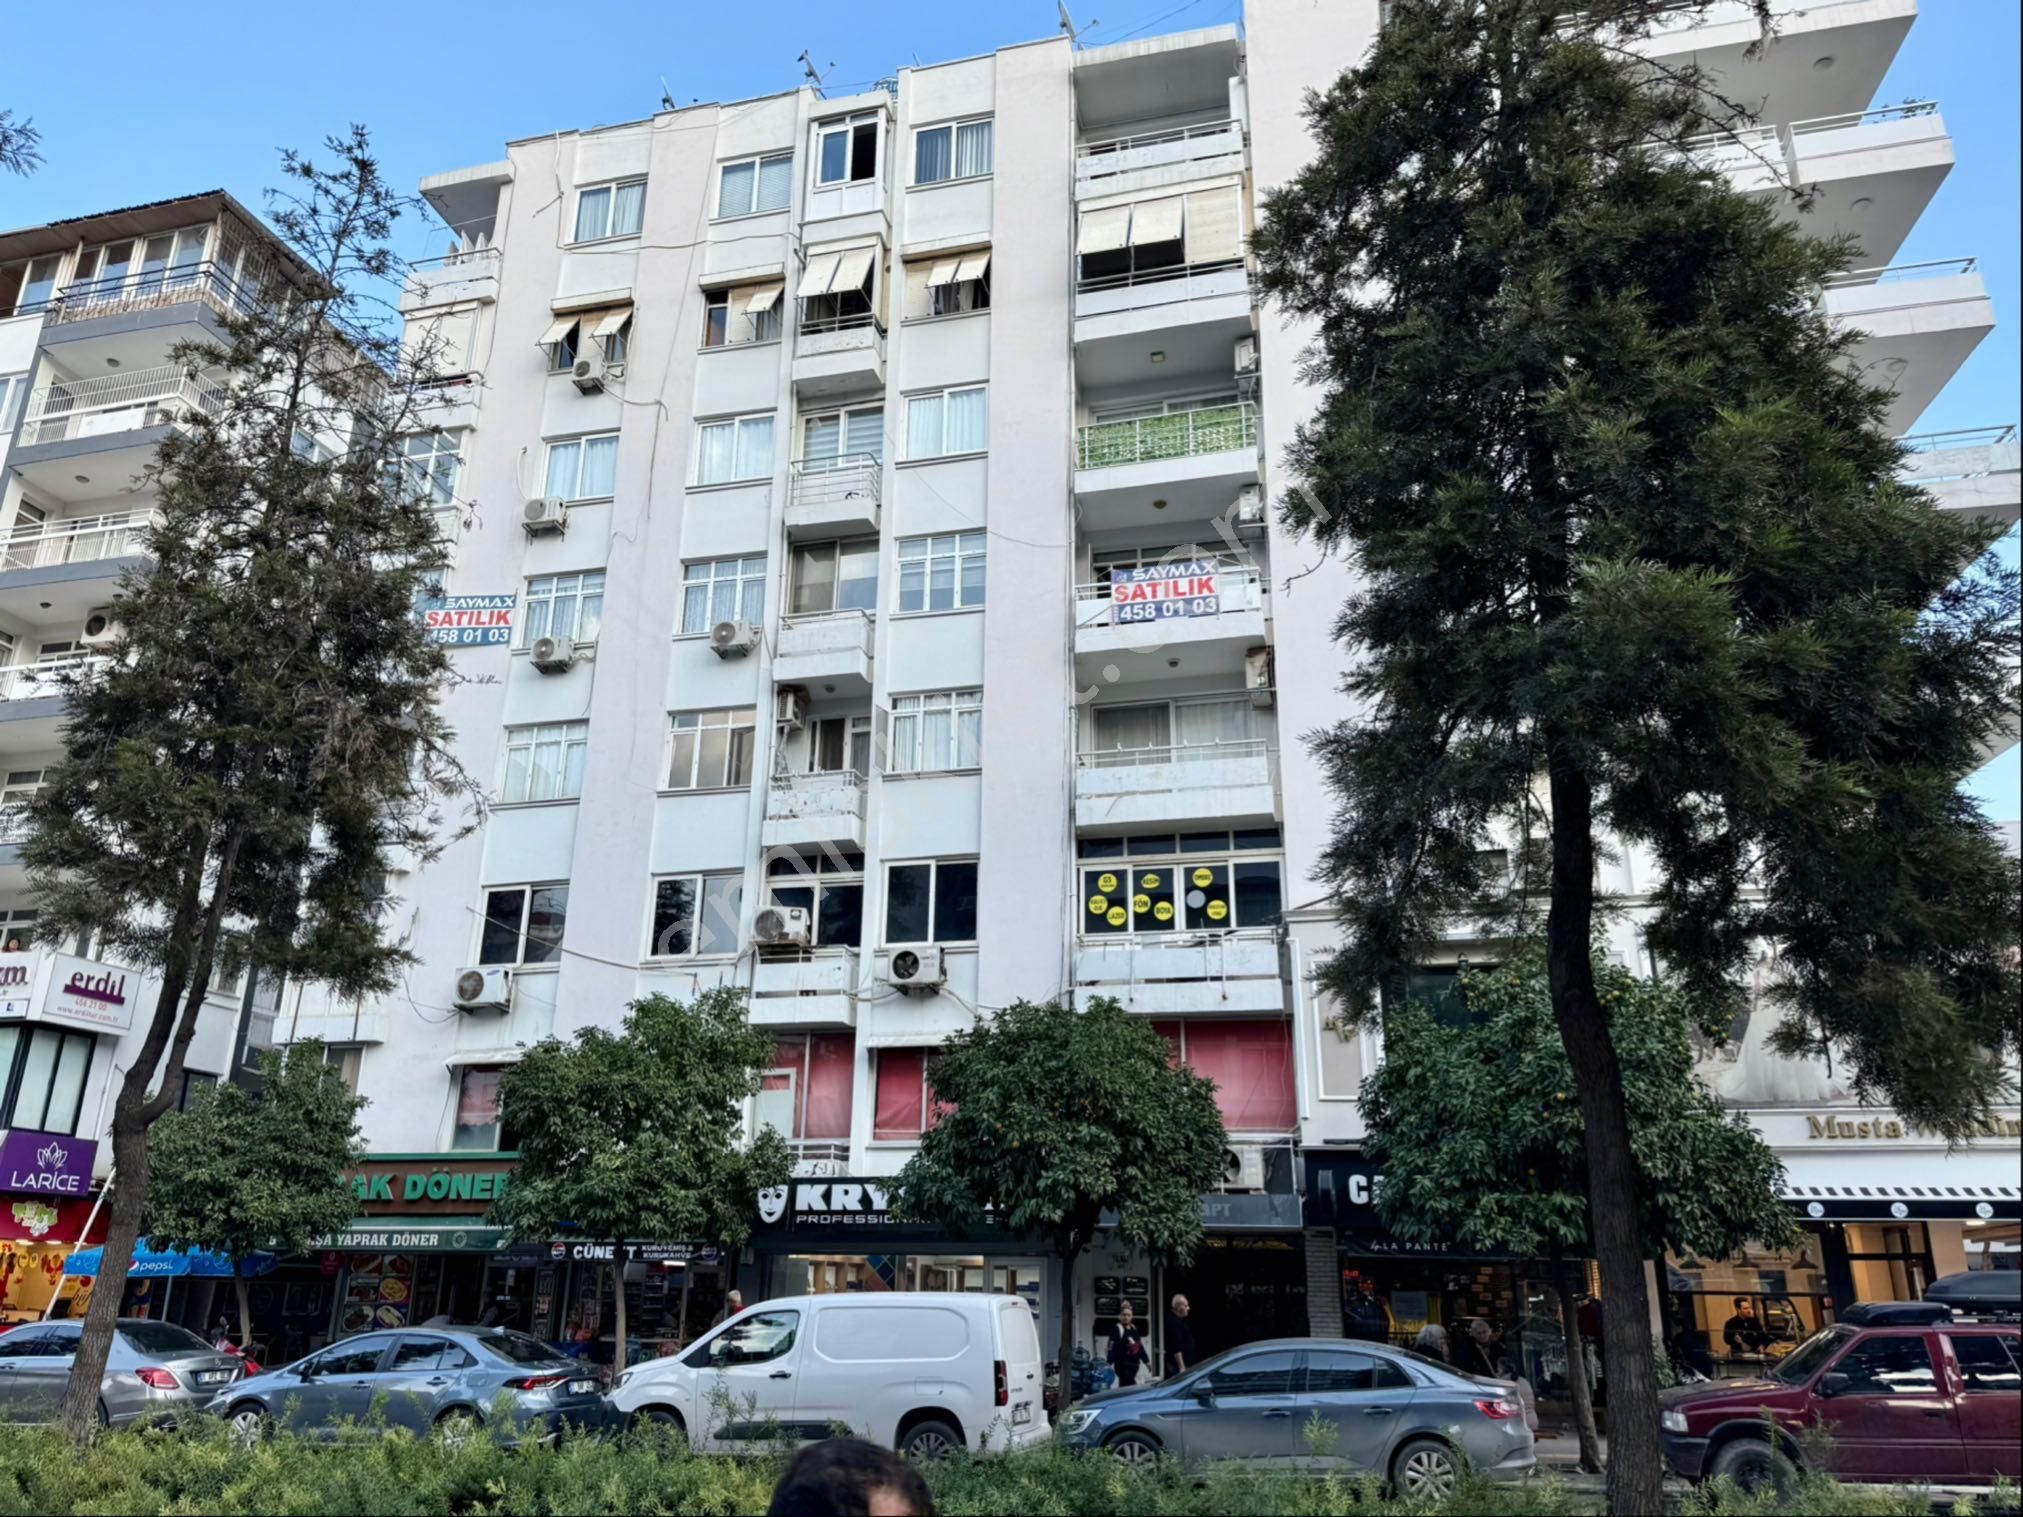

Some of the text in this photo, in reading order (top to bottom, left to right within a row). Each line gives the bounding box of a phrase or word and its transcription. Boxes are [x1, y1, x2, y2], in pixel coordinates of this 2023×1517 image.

[1132, 562, 1217, 581] SAYMAX
[1114, 576, 1216, 603] SATILIK
[445, 596, 515, 609] SAYMAX
[1120, 603, 1156, 621] 458
[1162, 601, 1185, 616] 01
[1193, 598, 1217, 614] 03
[426, 610, 512, 627] SATILIK
[463, 629, 483, 643] 01
[489, 628, 509, 642] 03
[1806, 1115, 1902, 1139] Musta
[337, 1234, 388, 1247] YAPRAK
[392, 1232, 439, 1247] DÖNER
[573, 1243, 638, 1260] CÜNET
[140, 1260, 173, 1272] pepsi
